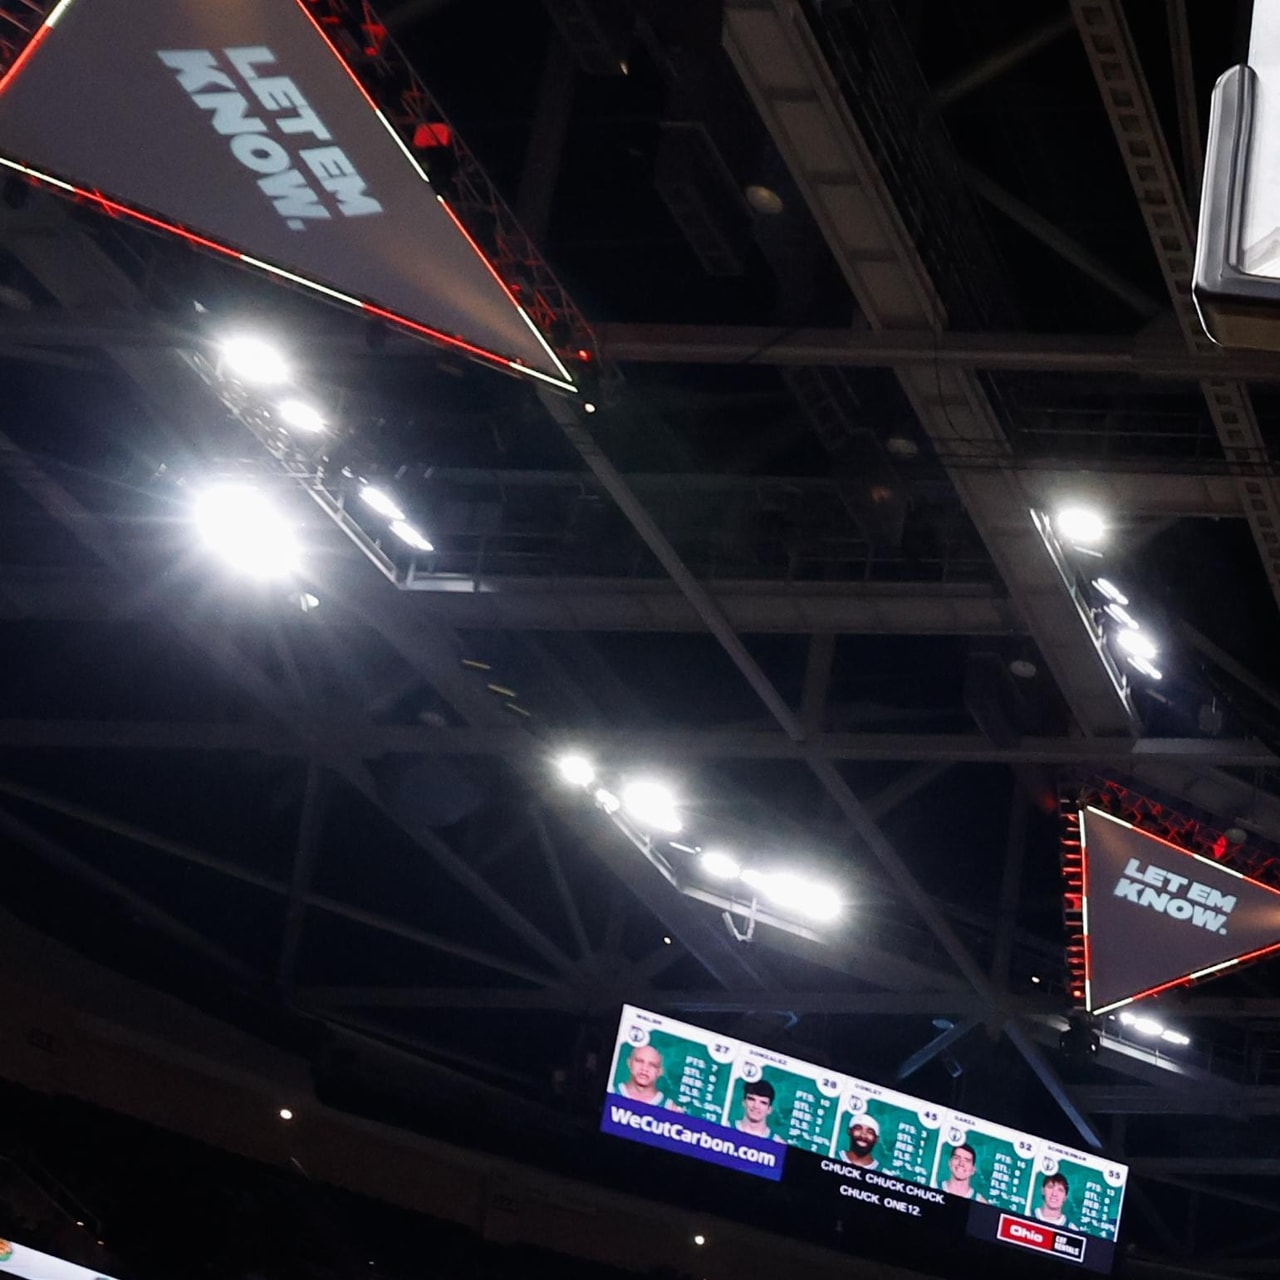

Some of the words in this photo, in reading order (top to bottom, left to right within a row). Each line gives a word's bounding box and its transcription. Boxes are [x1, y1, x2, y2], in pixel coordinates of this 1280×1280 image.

[156, 49, 331, 231] KNOW.
[223, 46, 332, 141] LET
[298, 143, 383, 218] EM
[1113, 878, 1228, 936] KNOW.
[1123, 858, 1188, 893] LET
[1187, 882, 1237, 913] EM
[611, 1105, 776, 1167] WeCutCarbon.com
[923, 1111, 938, 1121] 45
[1019, 1141, 1032, 1151] 52
[1009, 1224, 1044, 1243] Ohio
